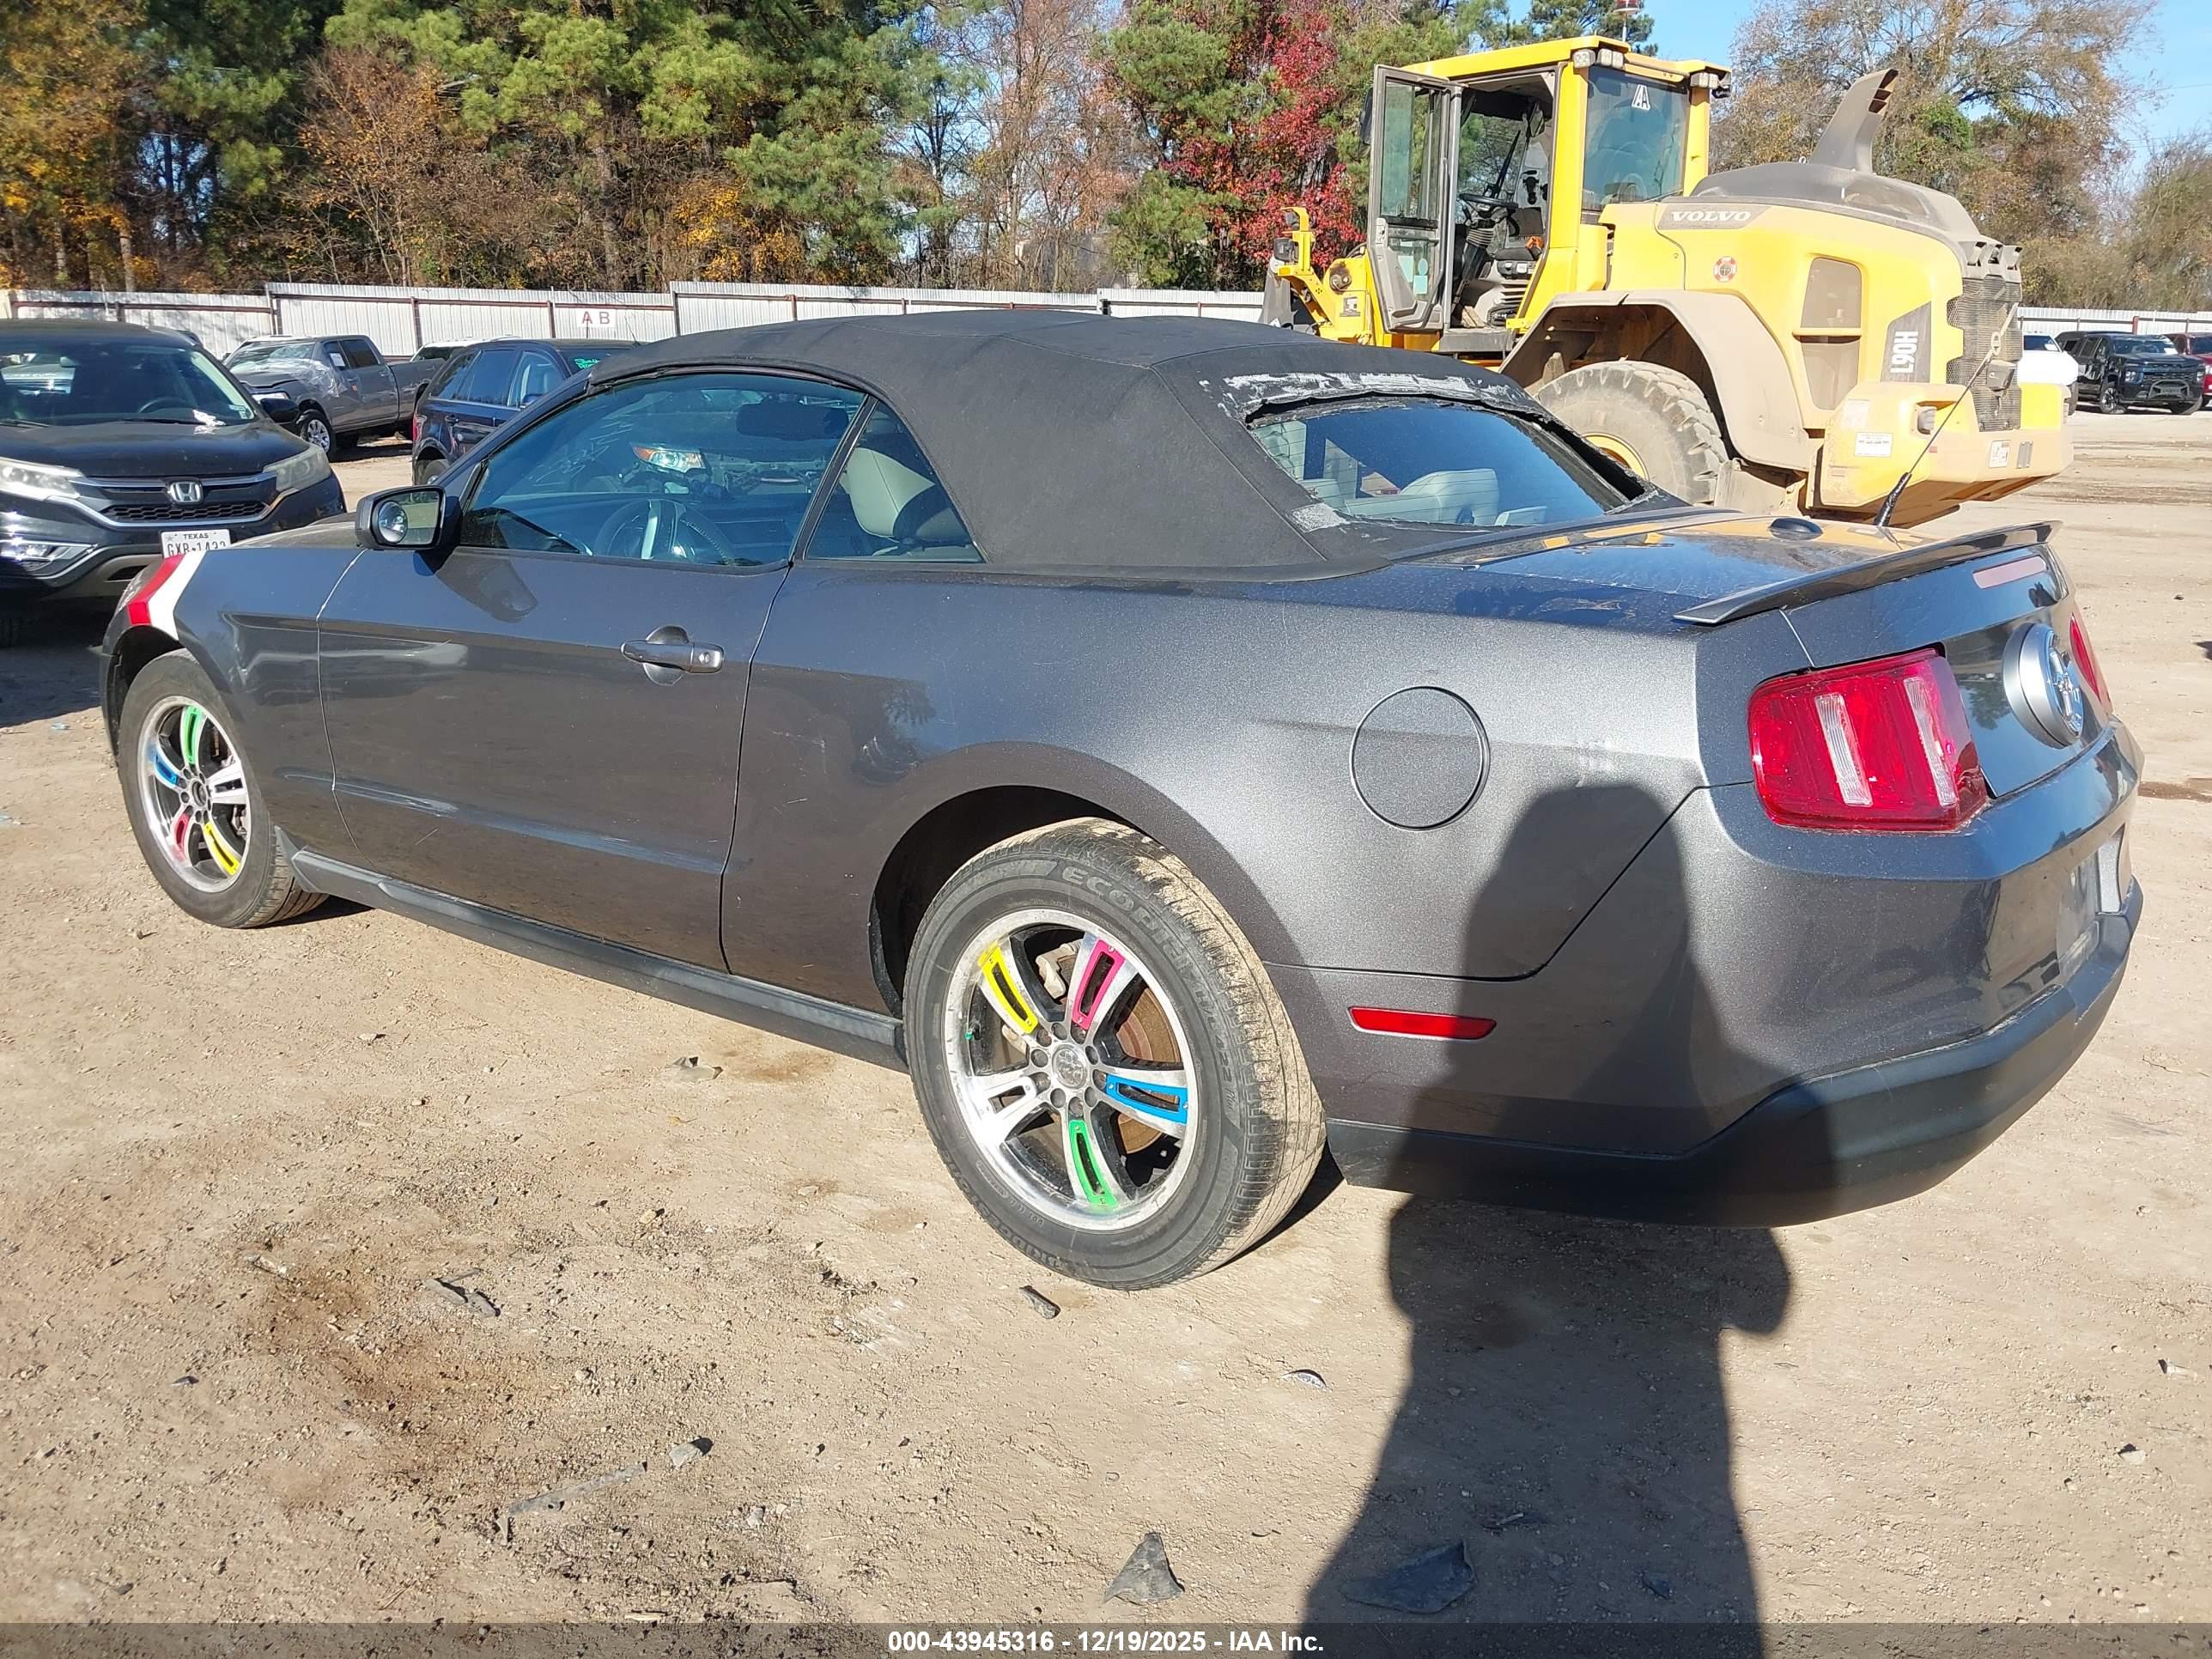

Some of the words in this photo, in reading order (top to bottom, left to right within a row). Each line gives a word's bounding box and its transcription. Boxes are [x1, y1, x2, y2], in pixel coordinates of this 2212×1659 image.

[1671, 210, 1752, 222] VOLVO
[582, 311, 593, 324] A
[599, 311, 611, 324] B
[1890, 331, 1919, 374] L90H
